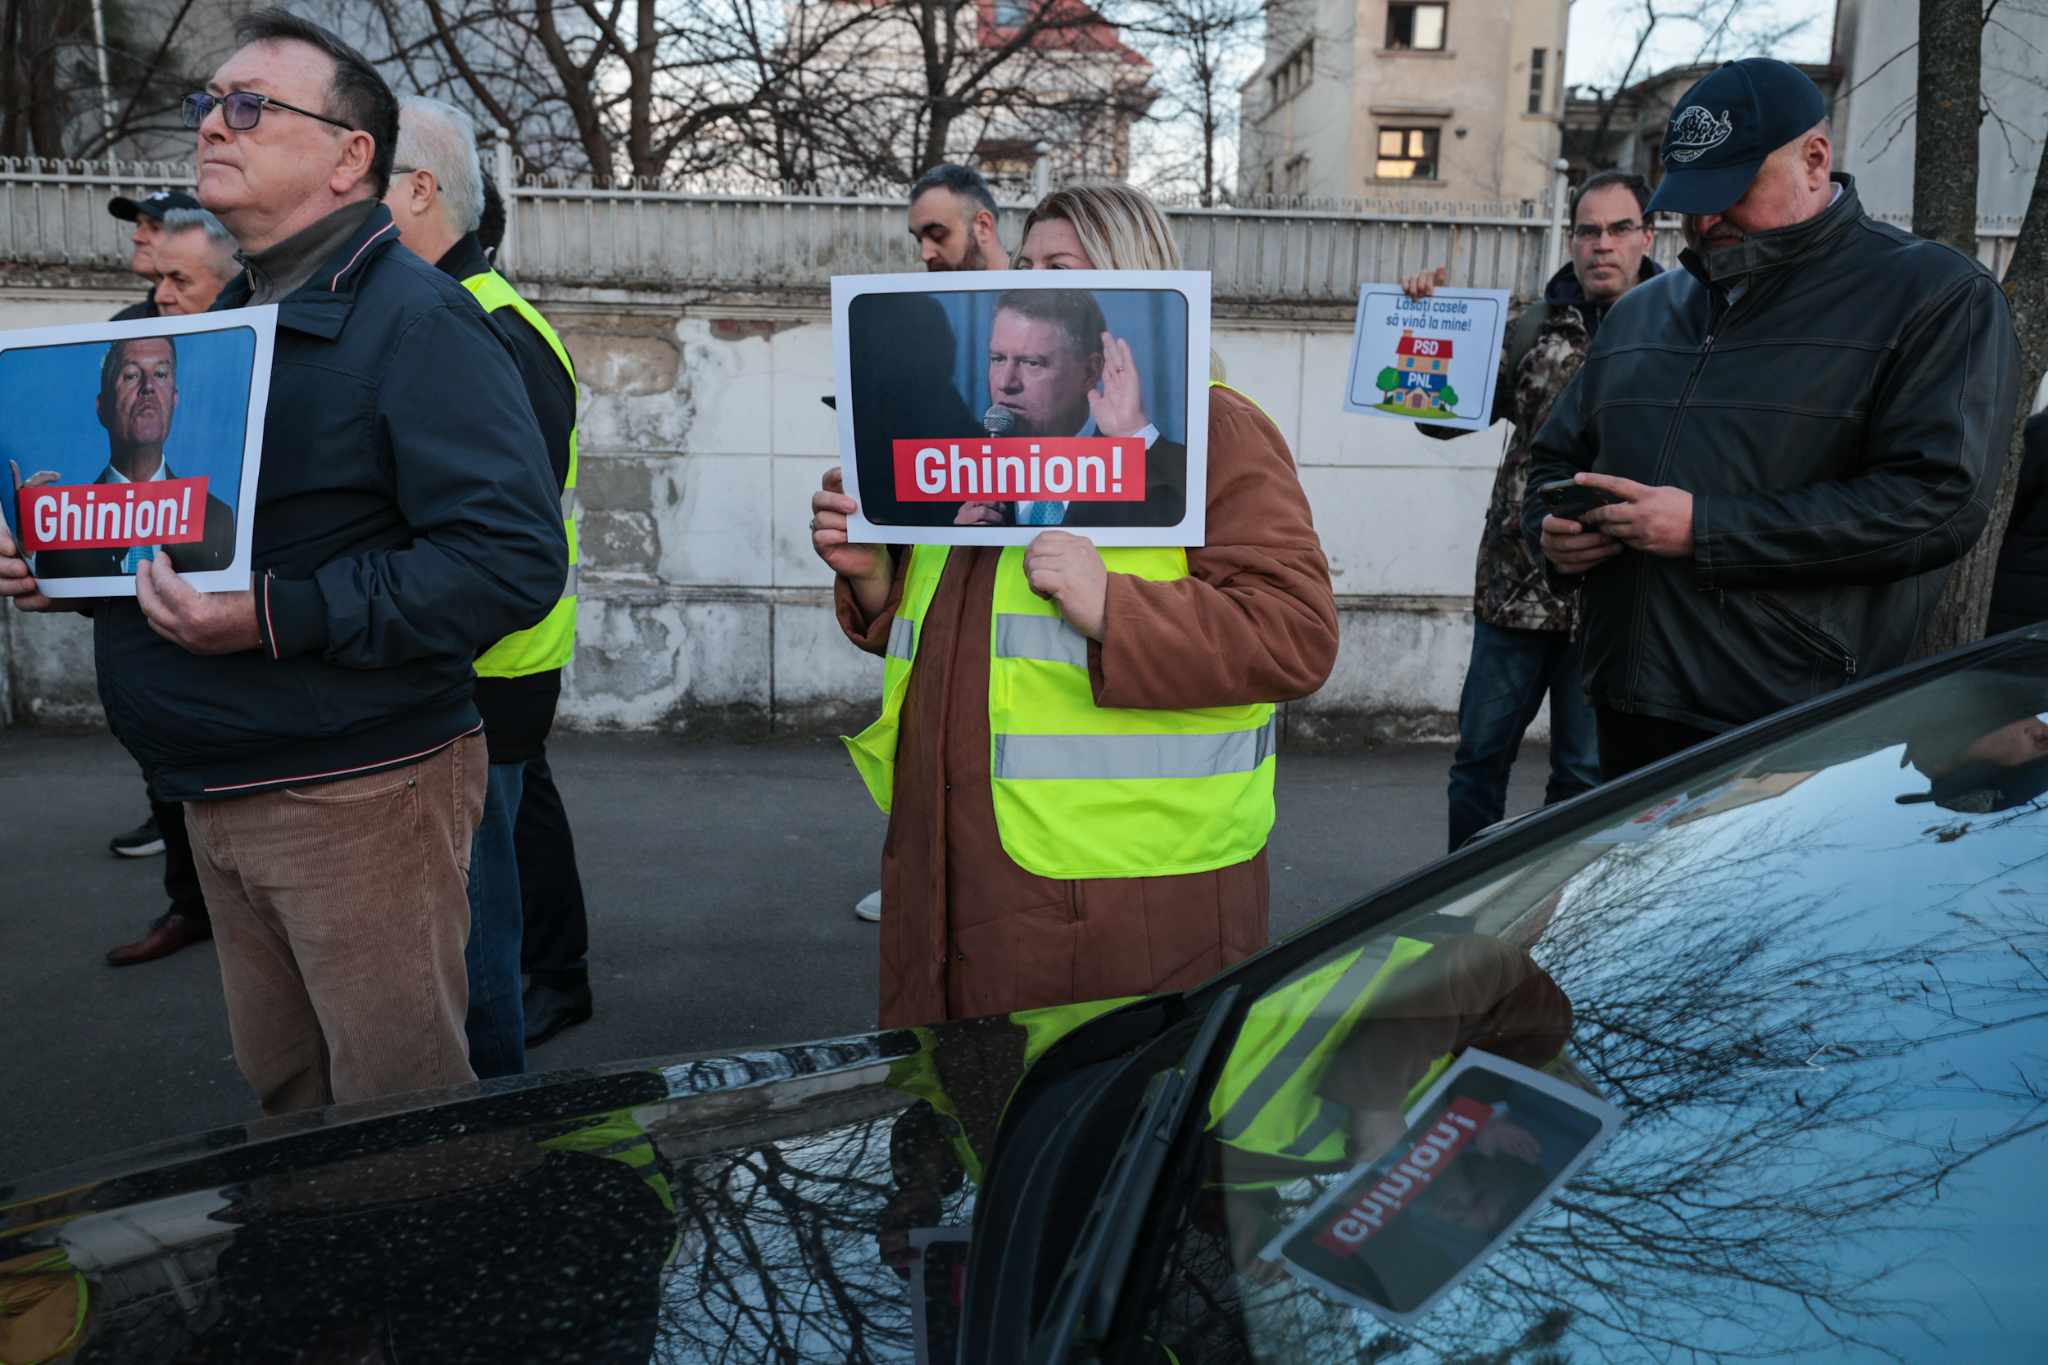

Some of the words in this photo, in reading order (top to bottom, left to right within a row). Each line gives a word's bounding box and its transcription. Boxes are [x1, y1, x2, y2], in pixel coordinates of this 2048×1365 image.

[1433, 300, 1468, 314] casele
[1386, 313, 1399, 326] să
[1429, 315, 1439, 329] la
[1441, 317, 1472, 332] mine!
[1413, 339, 1439, 355] PSD
[1408, 372, 1433, 389] PNL
[914, 444, 1123, 494] Ghinion!
[34, 487, 192, 543] Ghinion!
